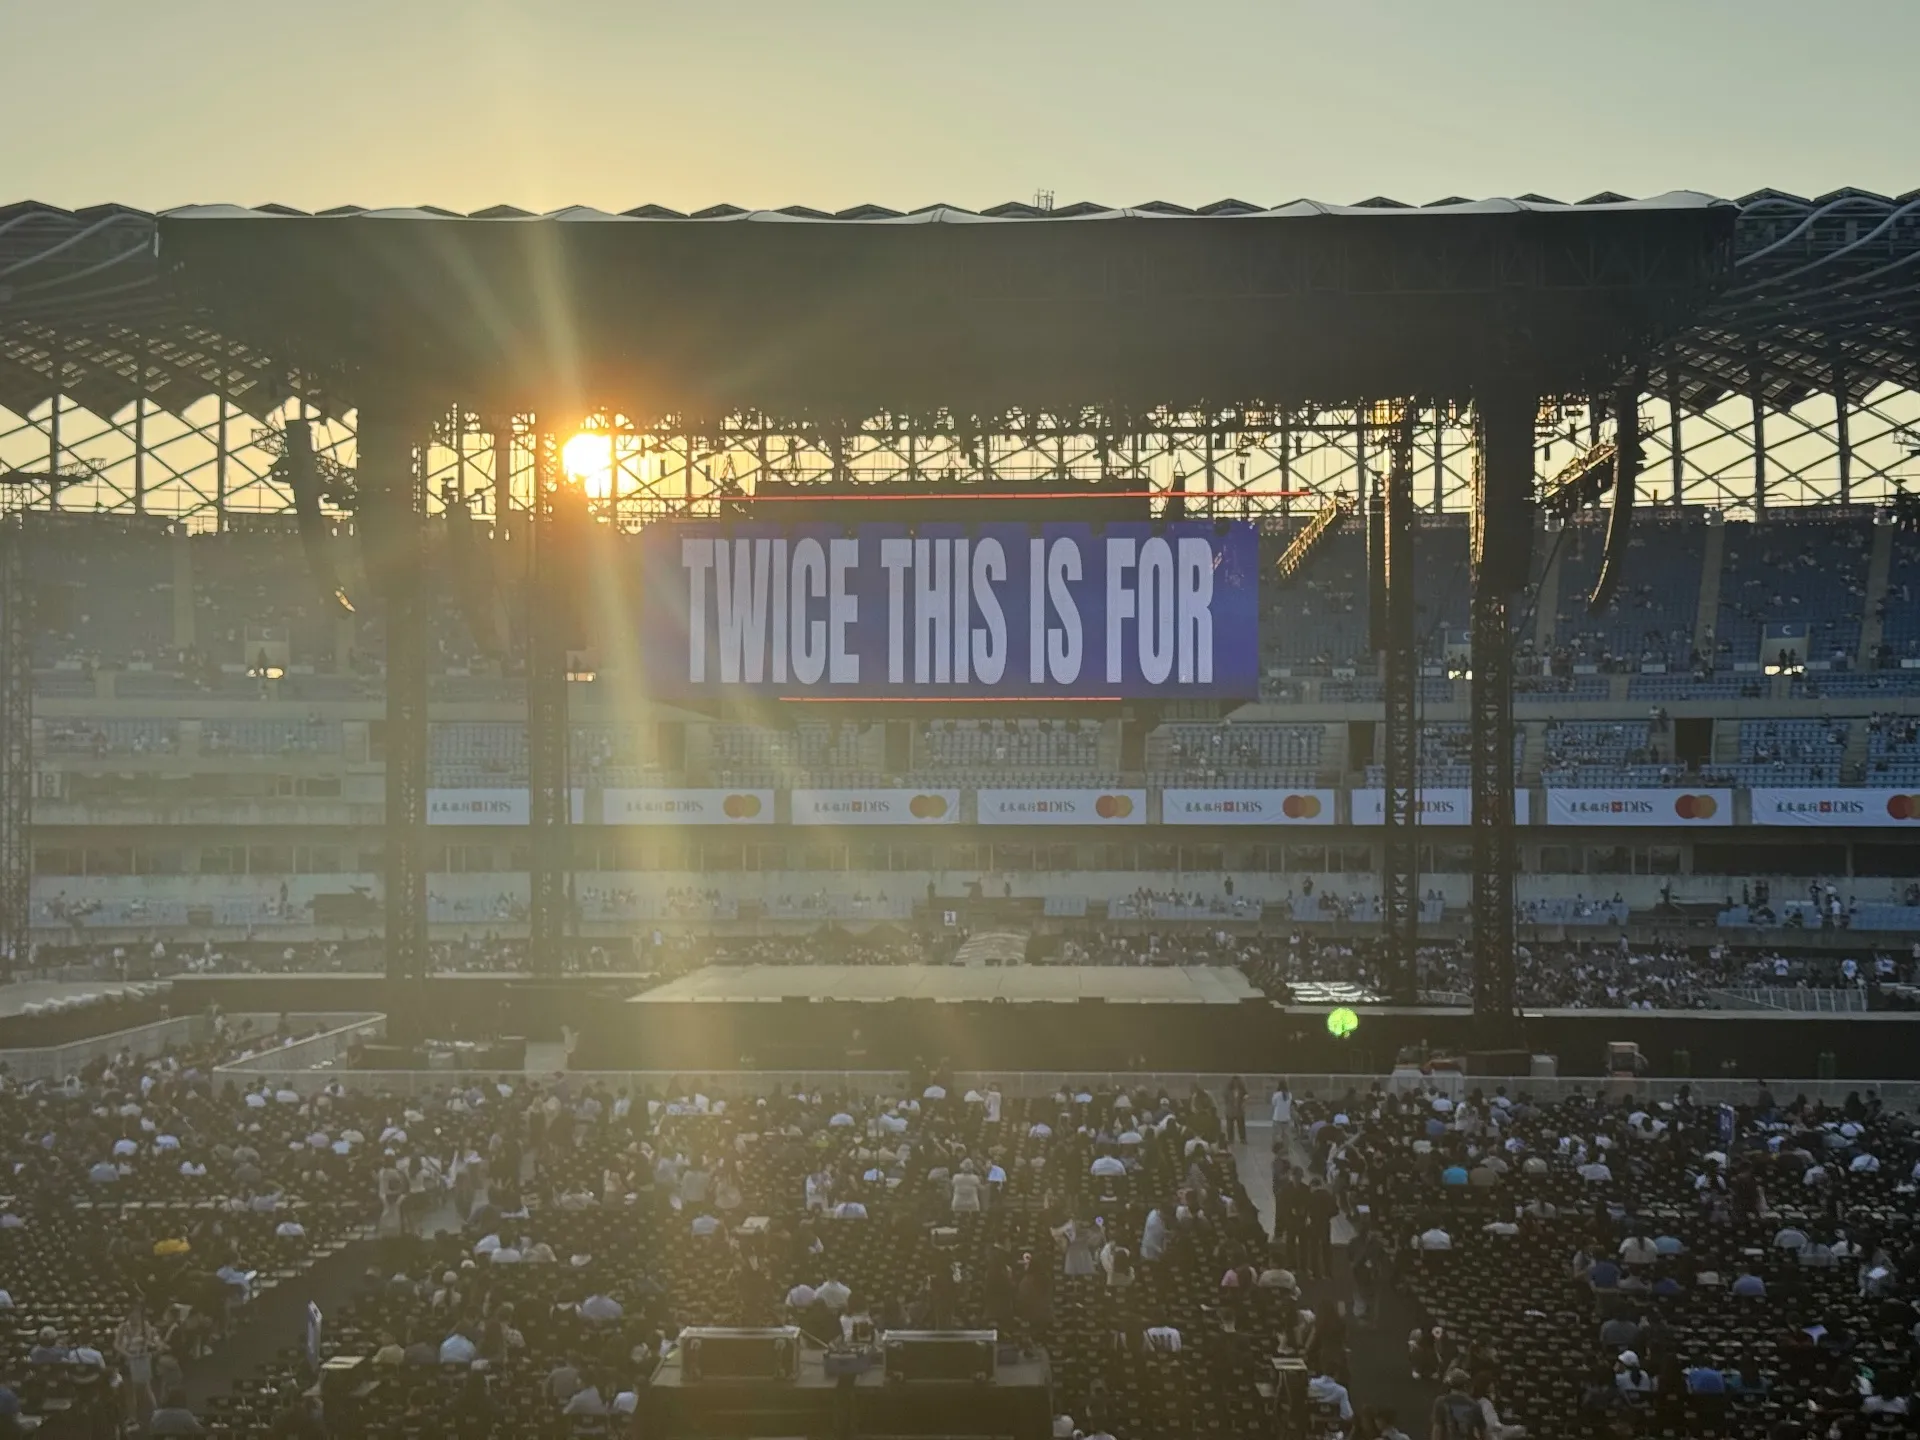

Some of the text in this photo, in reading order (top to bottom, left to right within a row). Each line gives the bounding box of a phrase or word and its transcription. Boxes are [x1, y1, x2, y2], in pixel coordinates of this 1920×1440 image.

[681, 537, 1214, 685] TWICE THIS IS FOR
[1782, 624, 1792, 635] C
[1236, 800, 1263, 813] DBS
[1427, 800, 1454, 813] DBS
[1624, 800, 1653, 813] DBS
[1833, 800, 1864, 813] DBS
